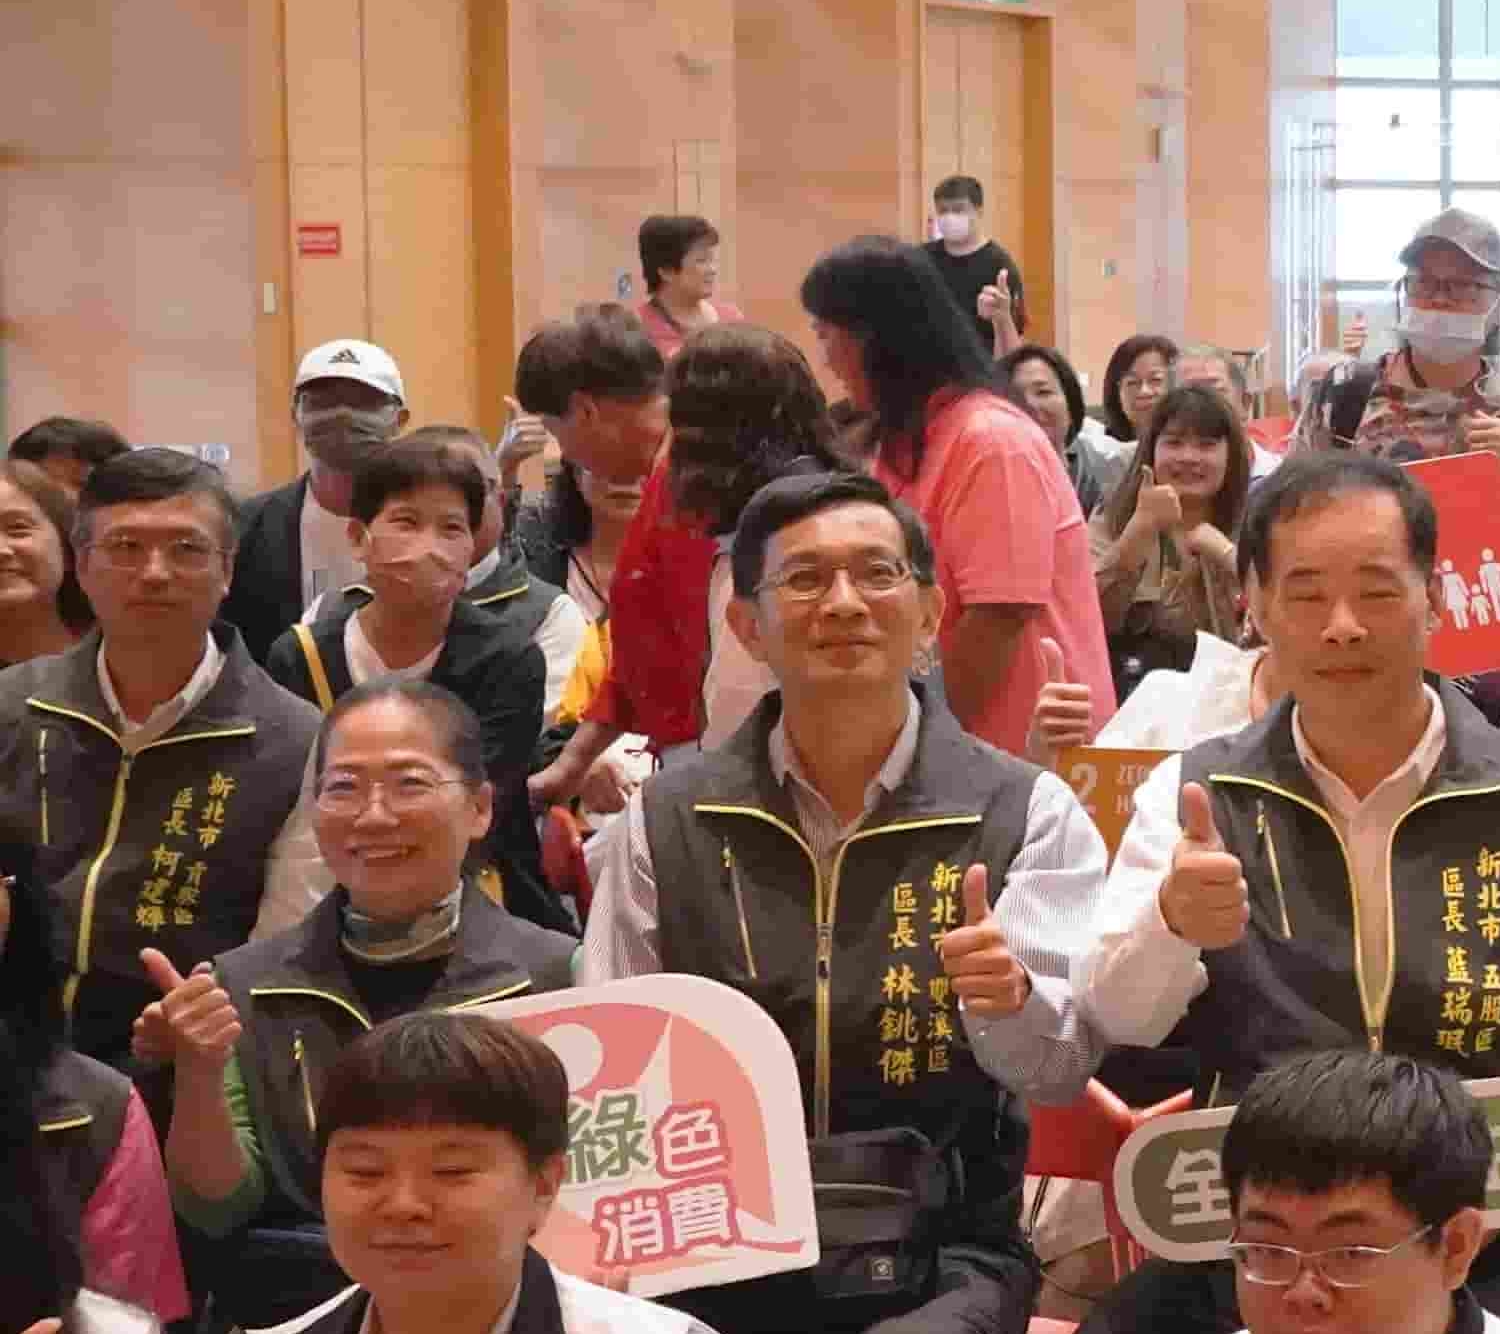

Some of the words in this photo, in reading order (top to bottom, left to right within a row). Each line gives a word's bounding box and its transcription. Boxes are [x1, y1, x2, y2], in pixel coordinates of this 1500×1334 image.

[198, 771, 238, 851] 新北市
[888, 883, 918, 948] 區長
[1442, 867, 1468, 932] 區長
[568, 1094, 732, 1179] 綠色
[598, 1181, 733, 1263] 消費
